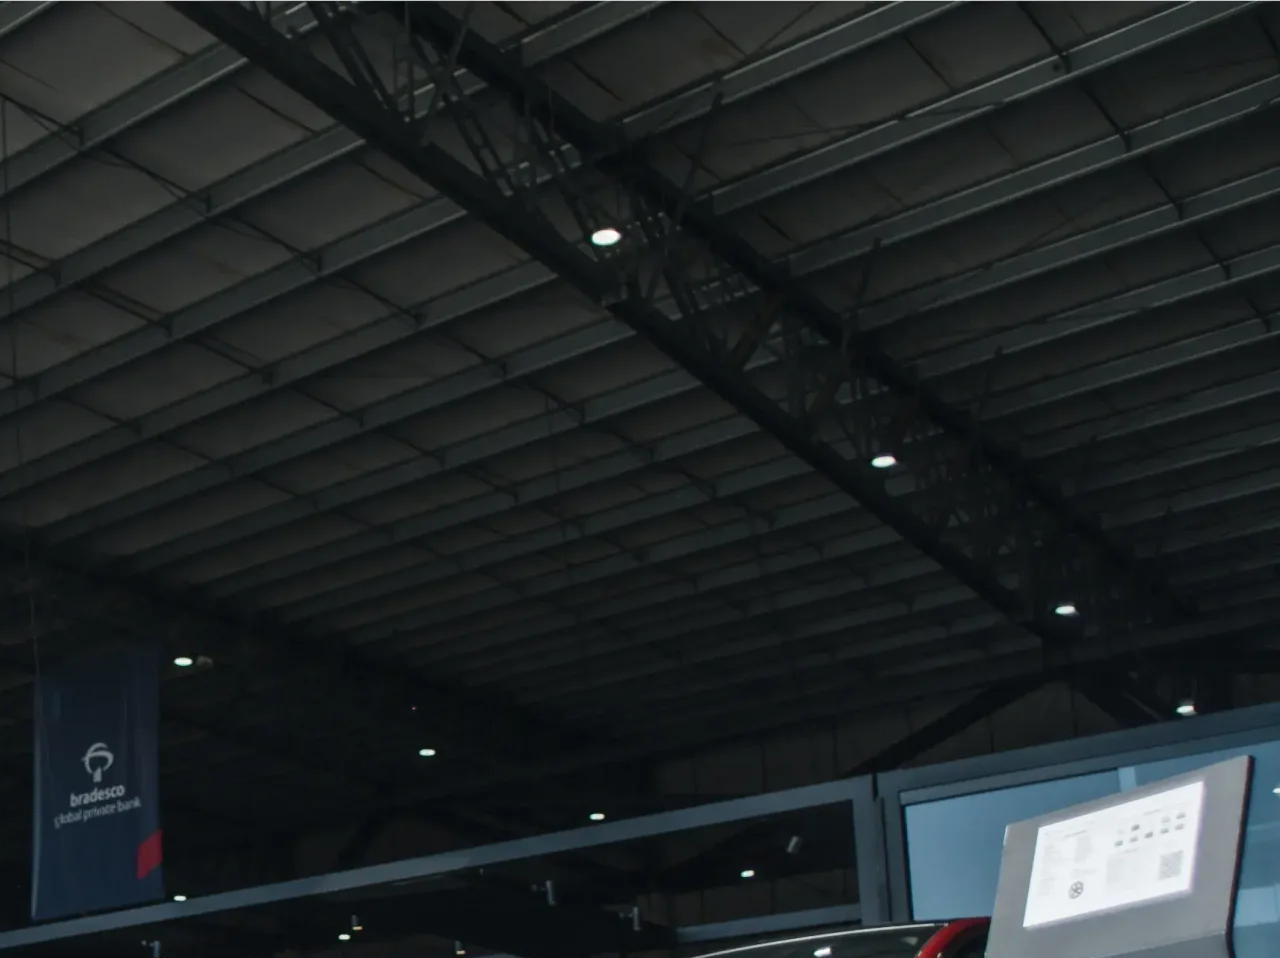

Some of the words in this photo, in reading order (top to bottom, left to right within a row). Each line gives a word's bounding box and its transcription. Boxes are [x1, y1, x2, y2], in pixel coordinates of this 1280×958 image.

[69, 784, 126, 808] bradesco
[53, 808, 83, 830] global
[82, 804, 117, 823] private
[116, 796, 141, 813] bank
